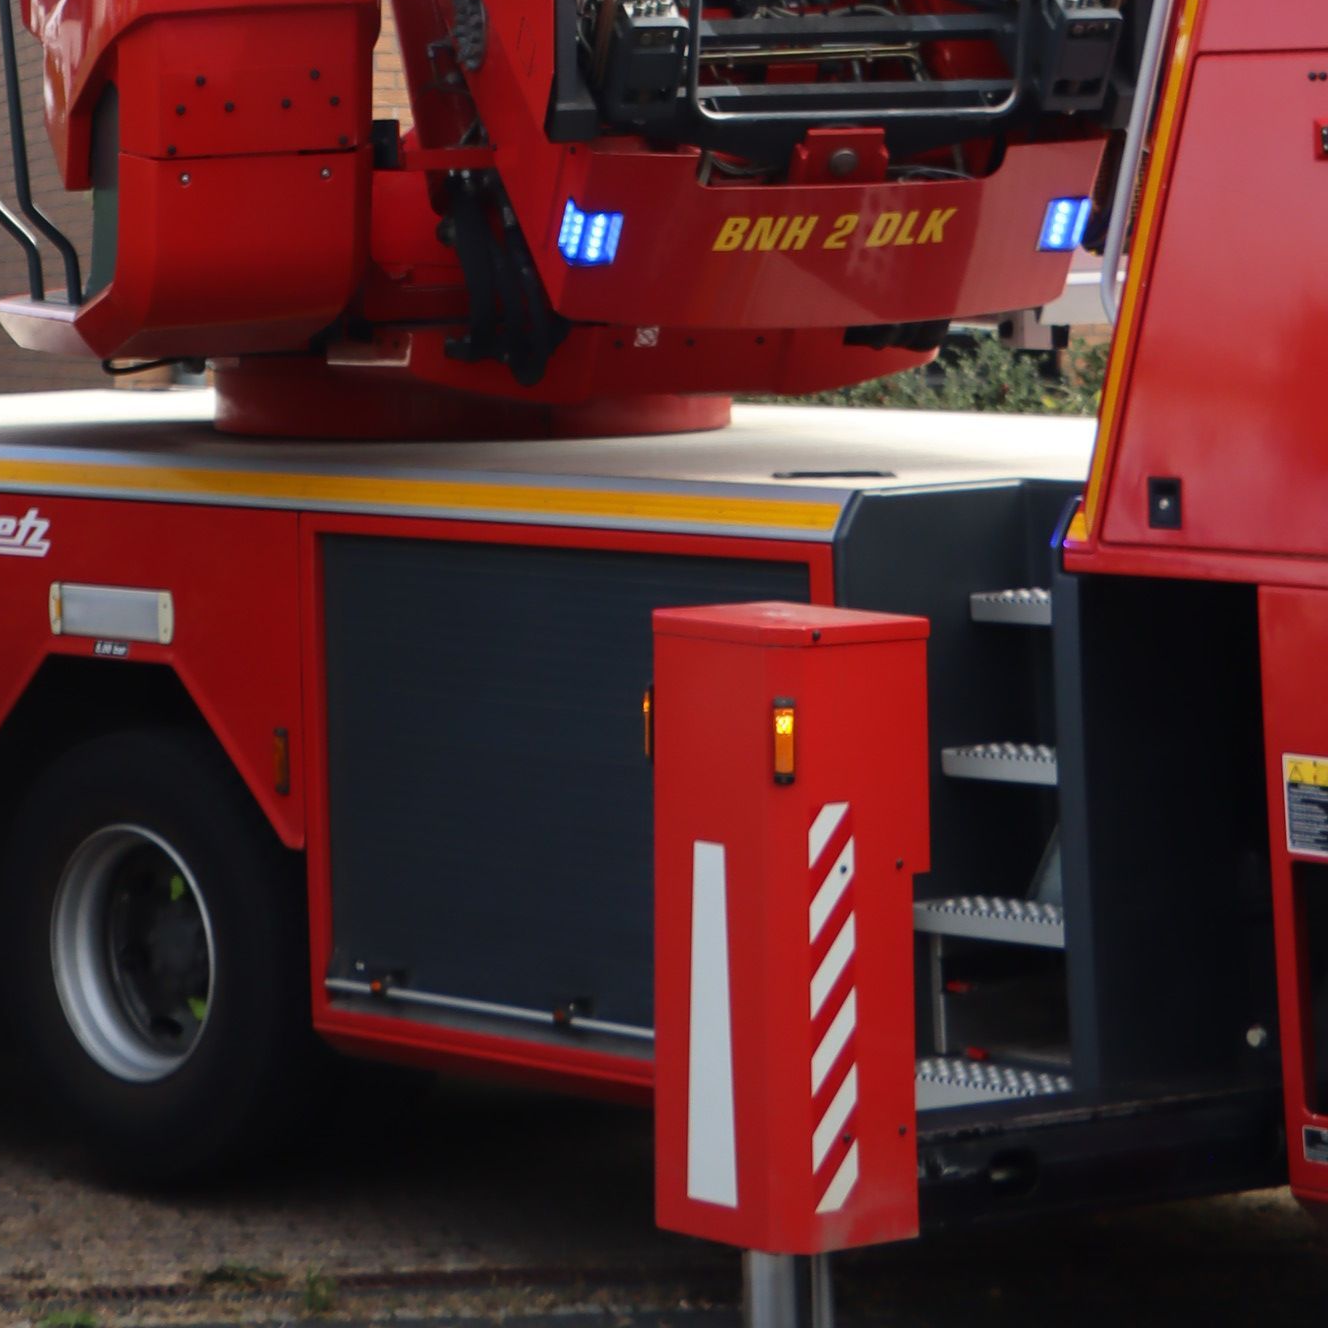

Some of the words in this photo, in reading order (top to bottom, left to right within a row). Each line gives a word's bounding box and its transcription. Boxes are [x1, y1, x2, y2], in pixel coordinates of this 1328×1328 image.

[712, 216, 819, 251] BNH
[823, 214, 859, 250] 2
[865, 207, 958, 248] DLK
